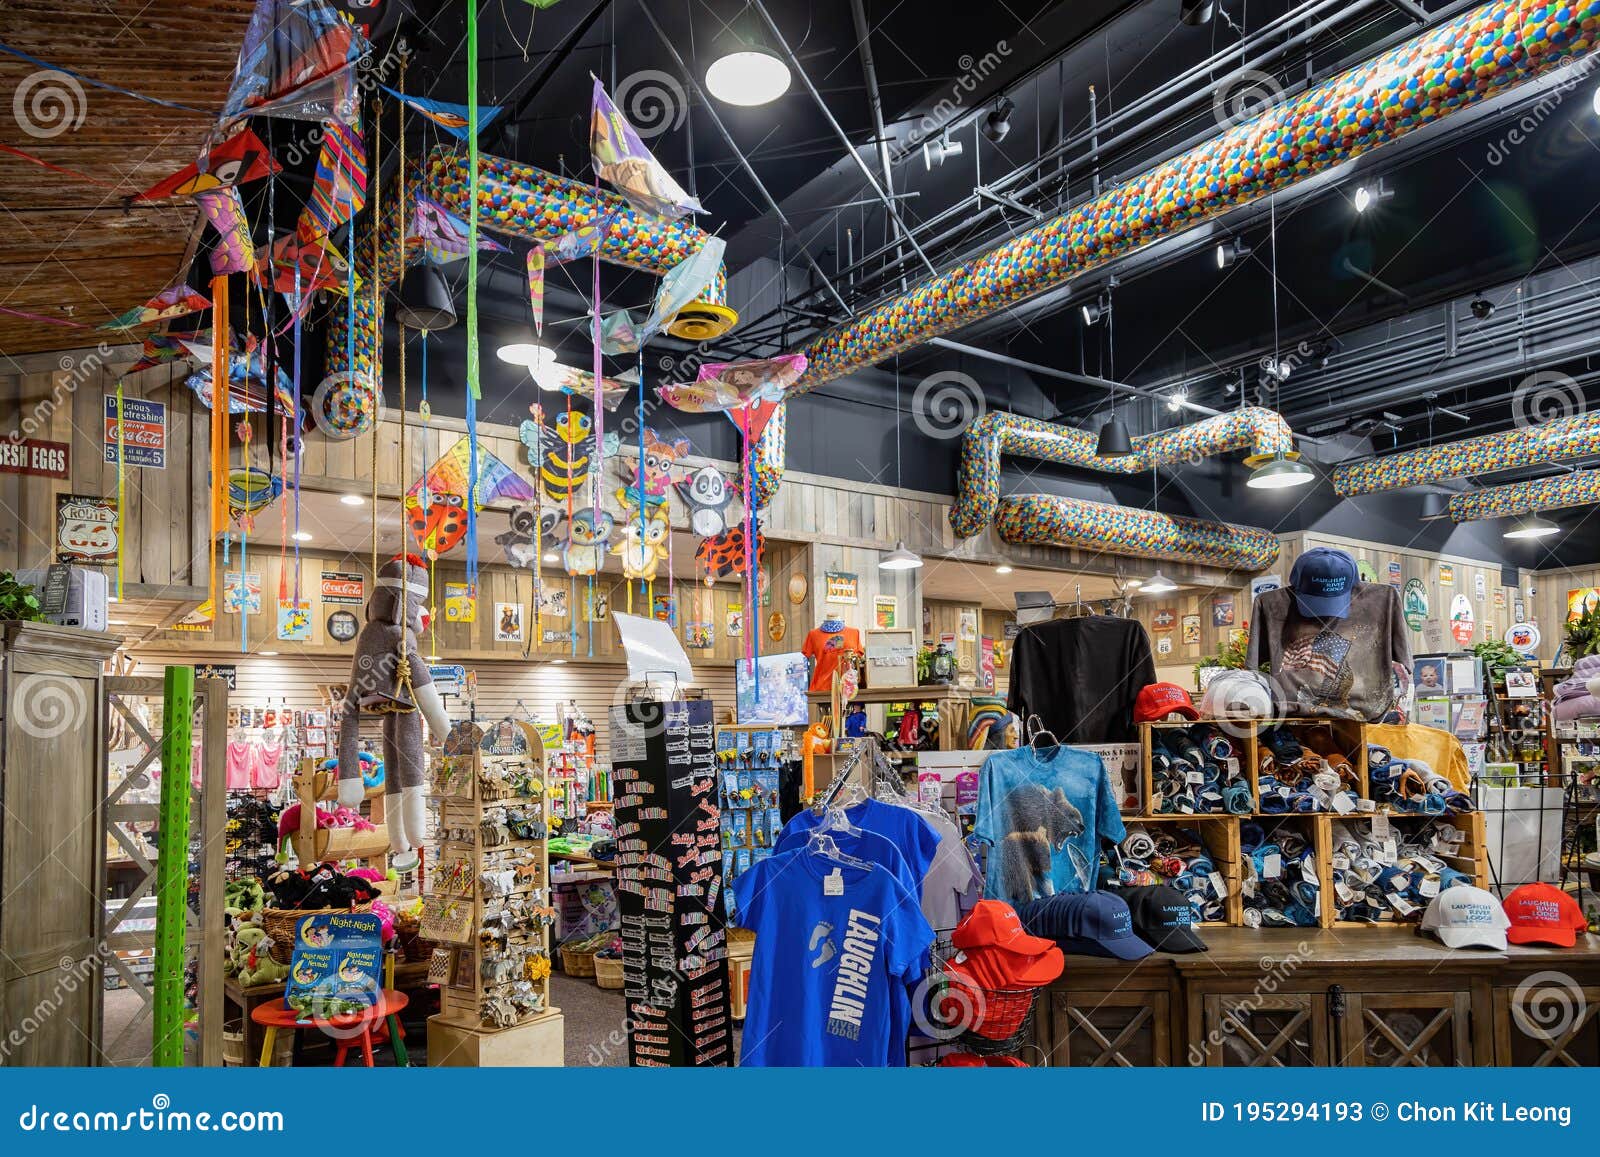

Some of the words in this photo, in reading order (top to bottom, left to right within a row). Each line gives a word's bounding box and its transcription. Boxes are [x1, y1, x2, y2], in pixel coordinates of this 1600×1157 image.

[108, 398, 151, 412] Dicious
[123, 410, 164, 424] efreshing
[108, 426, 163, 445] Coa-Cola
[32, 446, 65, 472] EGGS
[70, 507, 106, 521] ROUTE
[322, 581, 361, 595] Coca-Cola
[335, 622, 354, 635] 66
[1519, 899, 1559, 908] LAUGHLIN
[329, 916, 376, 932] Night-Night
[350, 958, 374, 967] Arizona
[829, 908, 881, 1027] LAUGHLIN
[826, 1022, 860, 1041] LODGE
[828, 1017, 860, 1032] RIVER
